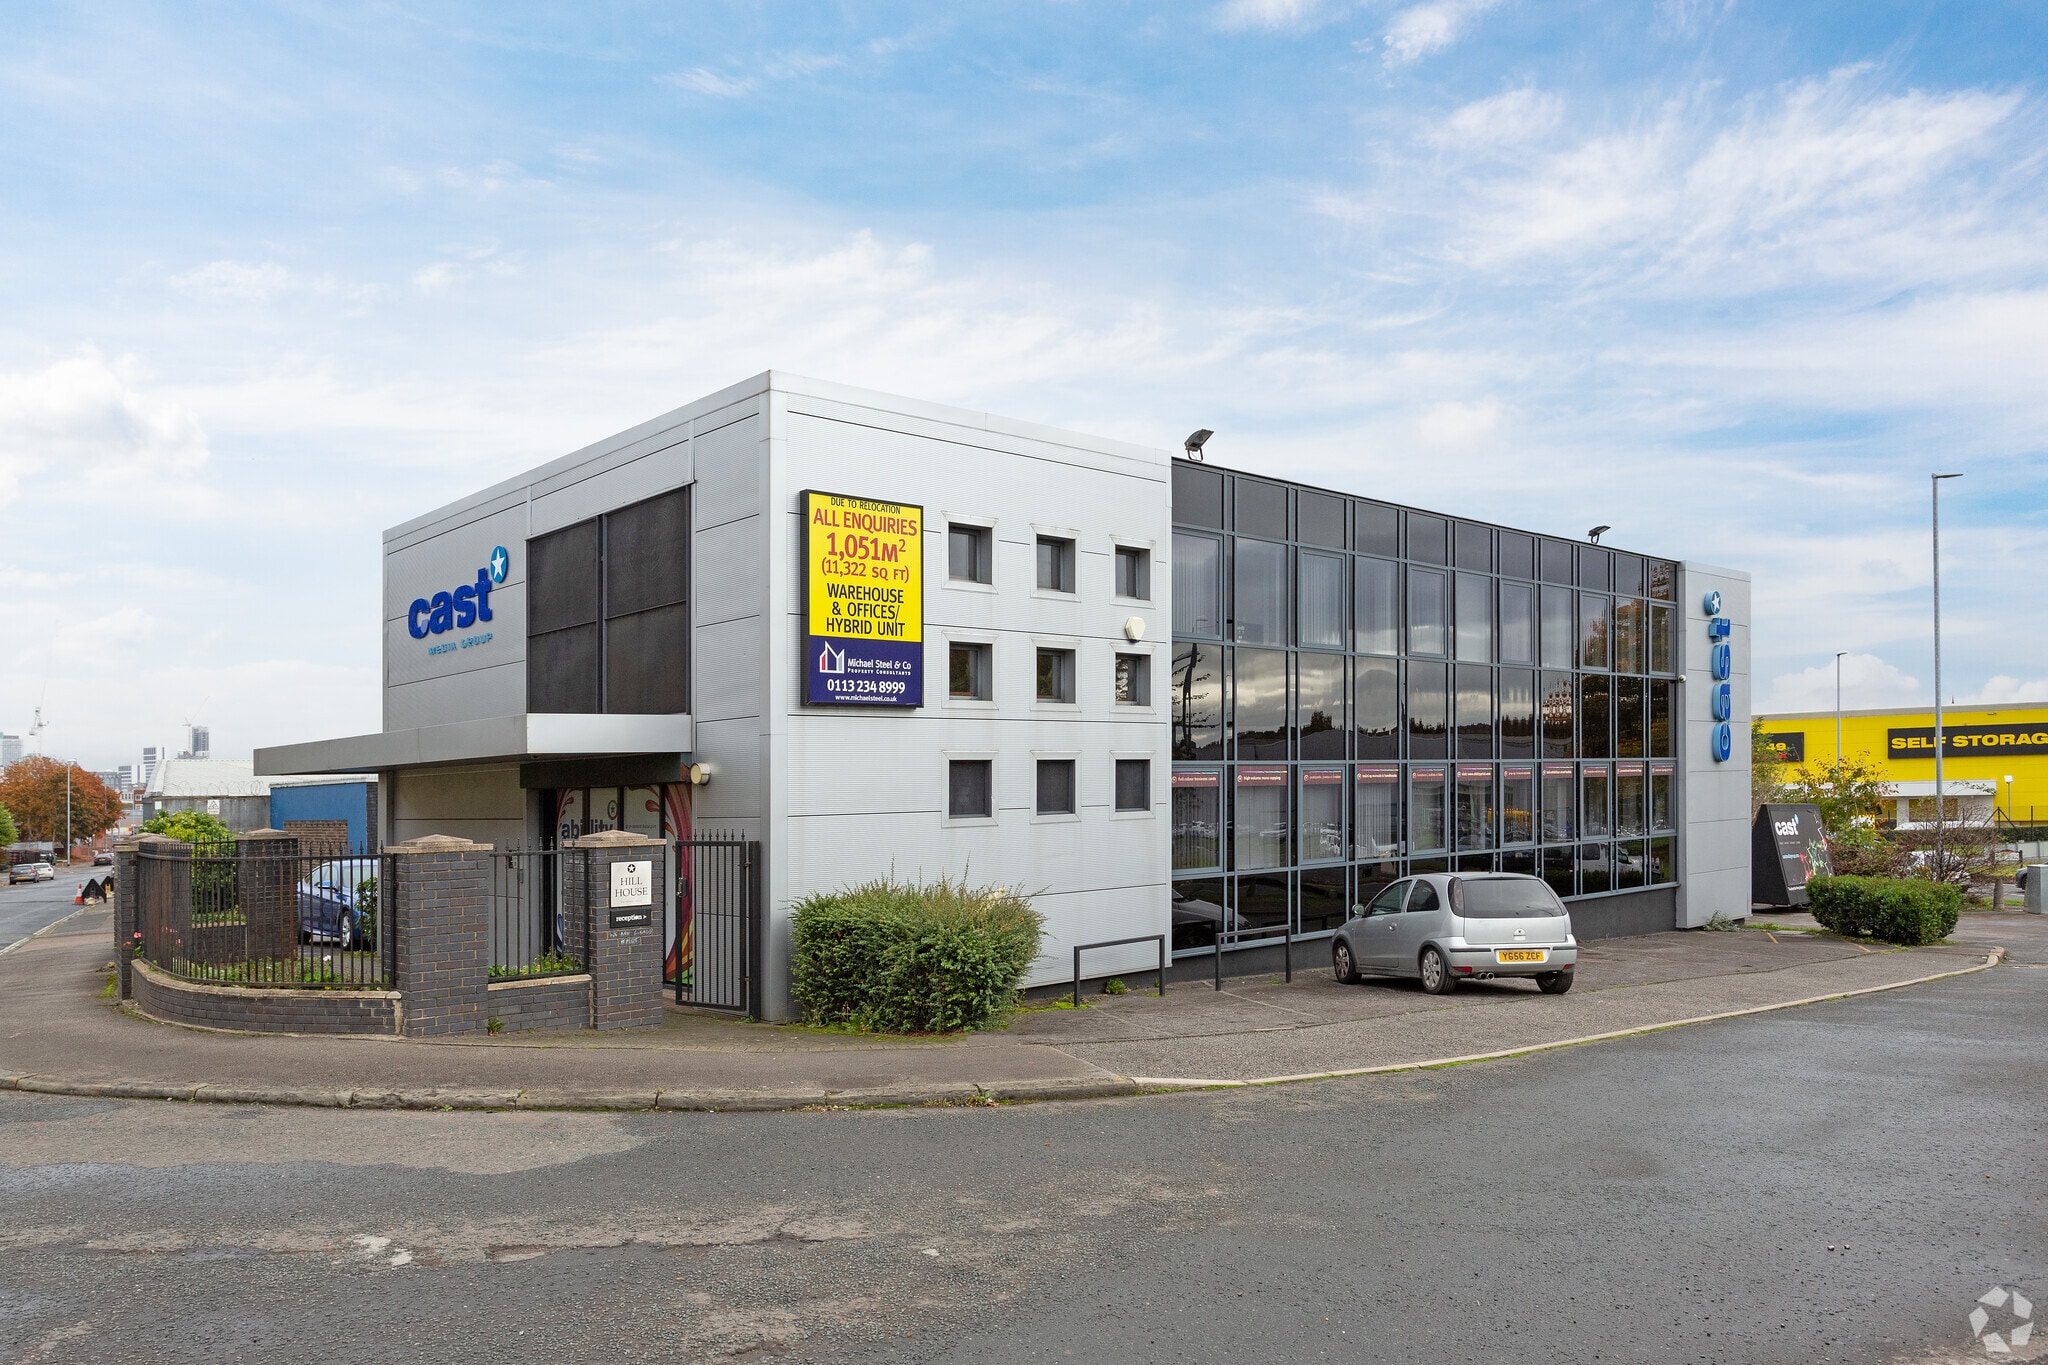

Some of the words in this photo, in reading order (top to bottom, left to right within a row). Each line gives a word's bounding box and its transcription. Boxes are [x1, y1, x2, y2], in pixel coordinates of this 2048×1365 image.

[831, 496, 845, 507] DUE
[847, 498, 857, 509] TO
[859, 500, 901, 515] RELOCATION
[813, 508, 840, 527] ALL
[843, 511, 917, 536] ENQUIRIES
[821, 557, 866, 579] (11,322
[872, 566, 888, 581] SQ
[893, 565, 909, 584] FT)
[827, 583, 904, 604] WAREHOUSE
[408, 567, 493, 639] cast
[832, 601, 841, 616] &
[826, 617, 872, 634] HYBRID
[877, 622, 905, 636] UNIT
[428, 642, 457, 655] MEDIA
[460, 632, 493, 648] GROUP
[847, 658, 873, 669] Michael
[875, 659, 893, 669] Steel
[894, 660, 901, 669] &
[902, 660, 911, 670] Co
[827, 679, 854, 692] 0113
[857, 680, 877, 693] 234
[878, 681, 905, 694] 8999
[835, 694, 897, 702] www.michaelsteel.co.uk
[1891, 736, 1946, 751] SELF
[1775, 818, 1798, 836] cast
[620, 877, 642, 886] HILL
[615, 888, 647, 897] HOUSE
[616, 914, 643, 923] reception
[1503, 952, 1524, 960] YG56
